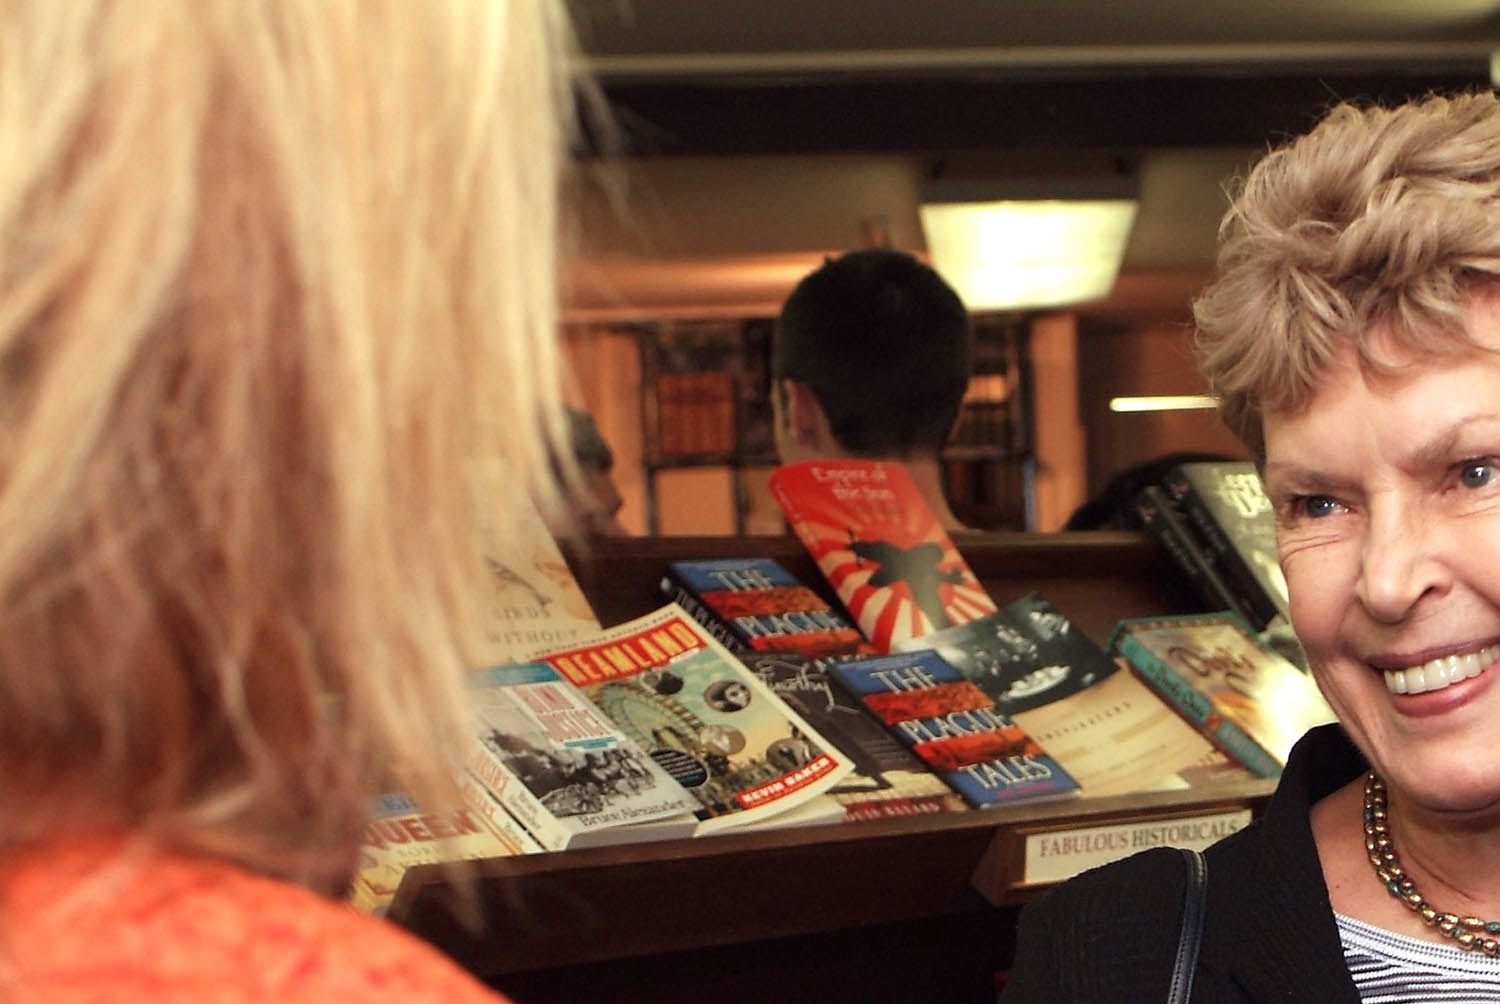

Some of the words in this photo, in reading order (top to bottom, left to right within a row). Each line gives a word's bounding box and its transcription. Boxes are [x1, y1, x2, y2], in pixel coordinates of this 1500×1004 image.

[708, 570, 774, 592] THE
[735, 611, 850, 639] PLAGUE
[870, 665, 938, 694] THE
[898, 708, 1017, 744] PLAGUE
[741, 780, 785, 803] KEVIN
[783, 757, 830, 787] BAKER
[957, 755, 1052, 789] TALES
[1040, 827, 1130, 858] FABULOUS
[1131, 818, 1239, 848] HISTORICALS
